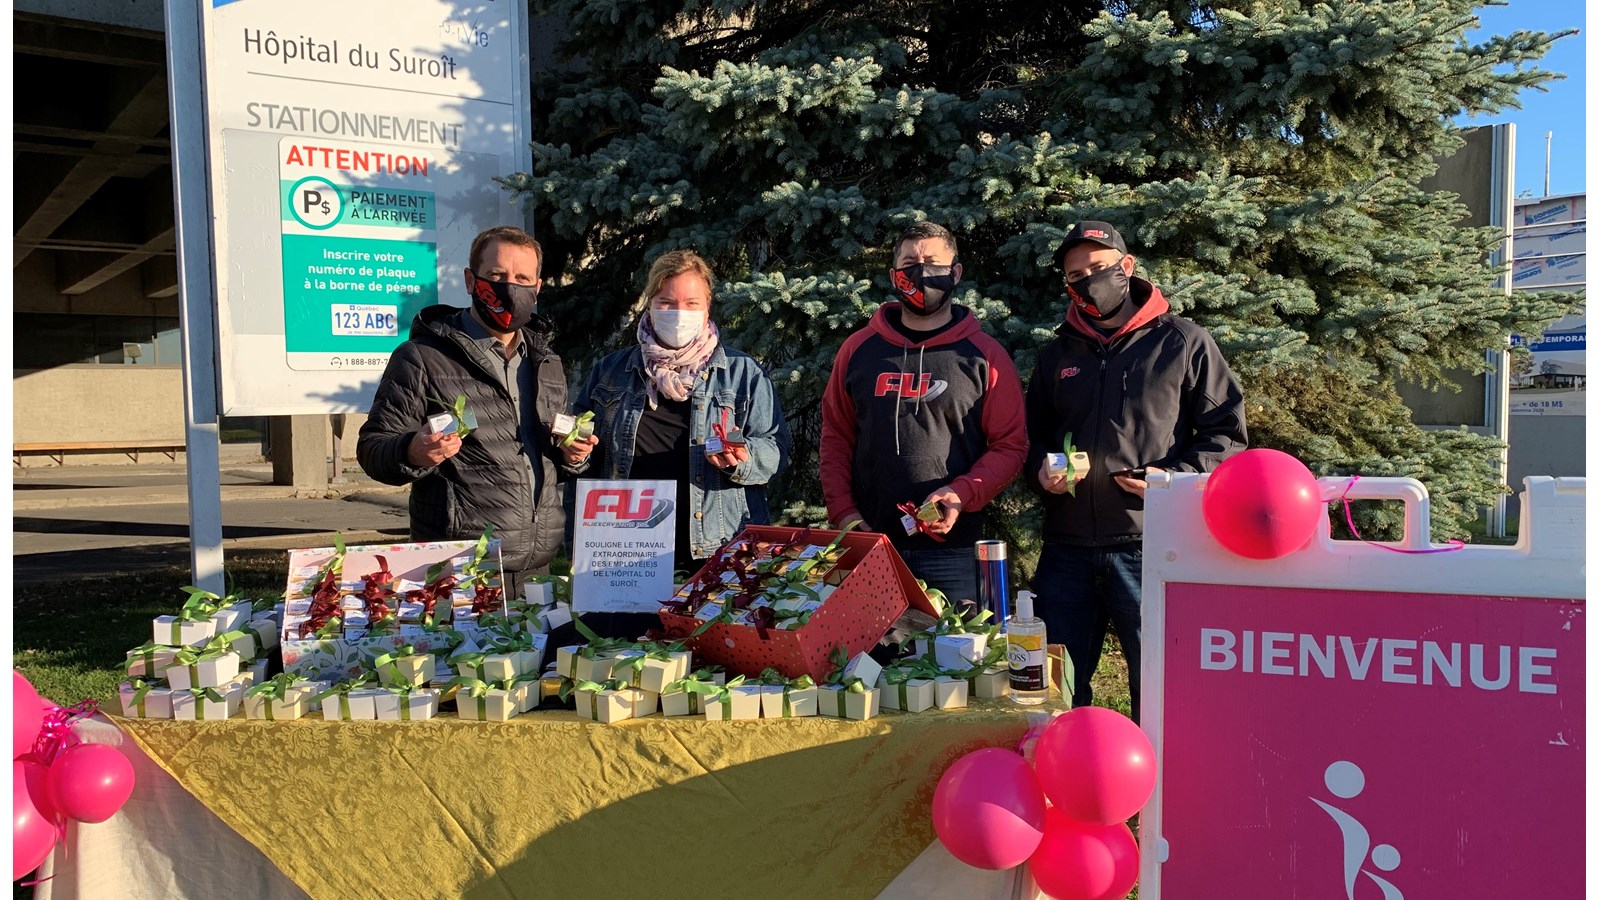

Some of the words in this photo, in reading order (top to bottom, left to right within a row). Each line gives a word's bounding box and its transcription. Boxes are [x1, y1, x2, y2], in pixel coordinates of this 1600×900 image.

[244, 28, 337, 64] Hôpital
[349, 44, 378, 69] du
[390, 48, 457, 80] Suroît
[246, 102, 463, 146] STATIONNEMENT
[286, 145, 428, 177] ATTENTION
[351, 191, 427, 209] PAIEMENT
[351, 205, 360, 219] À
[364, 208, 426, 224] L'ARRIVÉE
[323, 248, 370, 261] Inscrire
[374, 252, 404, 262] votre
[308, 264, 355, 276] numéro
[359, 266, 373, 276] de
[377, 267, 416, 279] plaque
[304, 278, 311, 289] à
[314, 279, 326, 290] la
[330, 280, 365, 291] borne
[368, 281, 382, 292] de
[386, 282, 421, 294] péage
[335, 312, 360, 328] 123
[365, 313, 395, 329] ABC
[351, 358, 389, 366] 888-887-7
[585, 541, 622, 549] SOULIGNE
[635, 541, 666, 549] TRAVAIL
[608, 560, 658, 568] EMPLOYÉ(E)S
[605, 569, 643, 577] L'HÔPITAL
[1200, 628, 1558, 694] BIENVENUE
